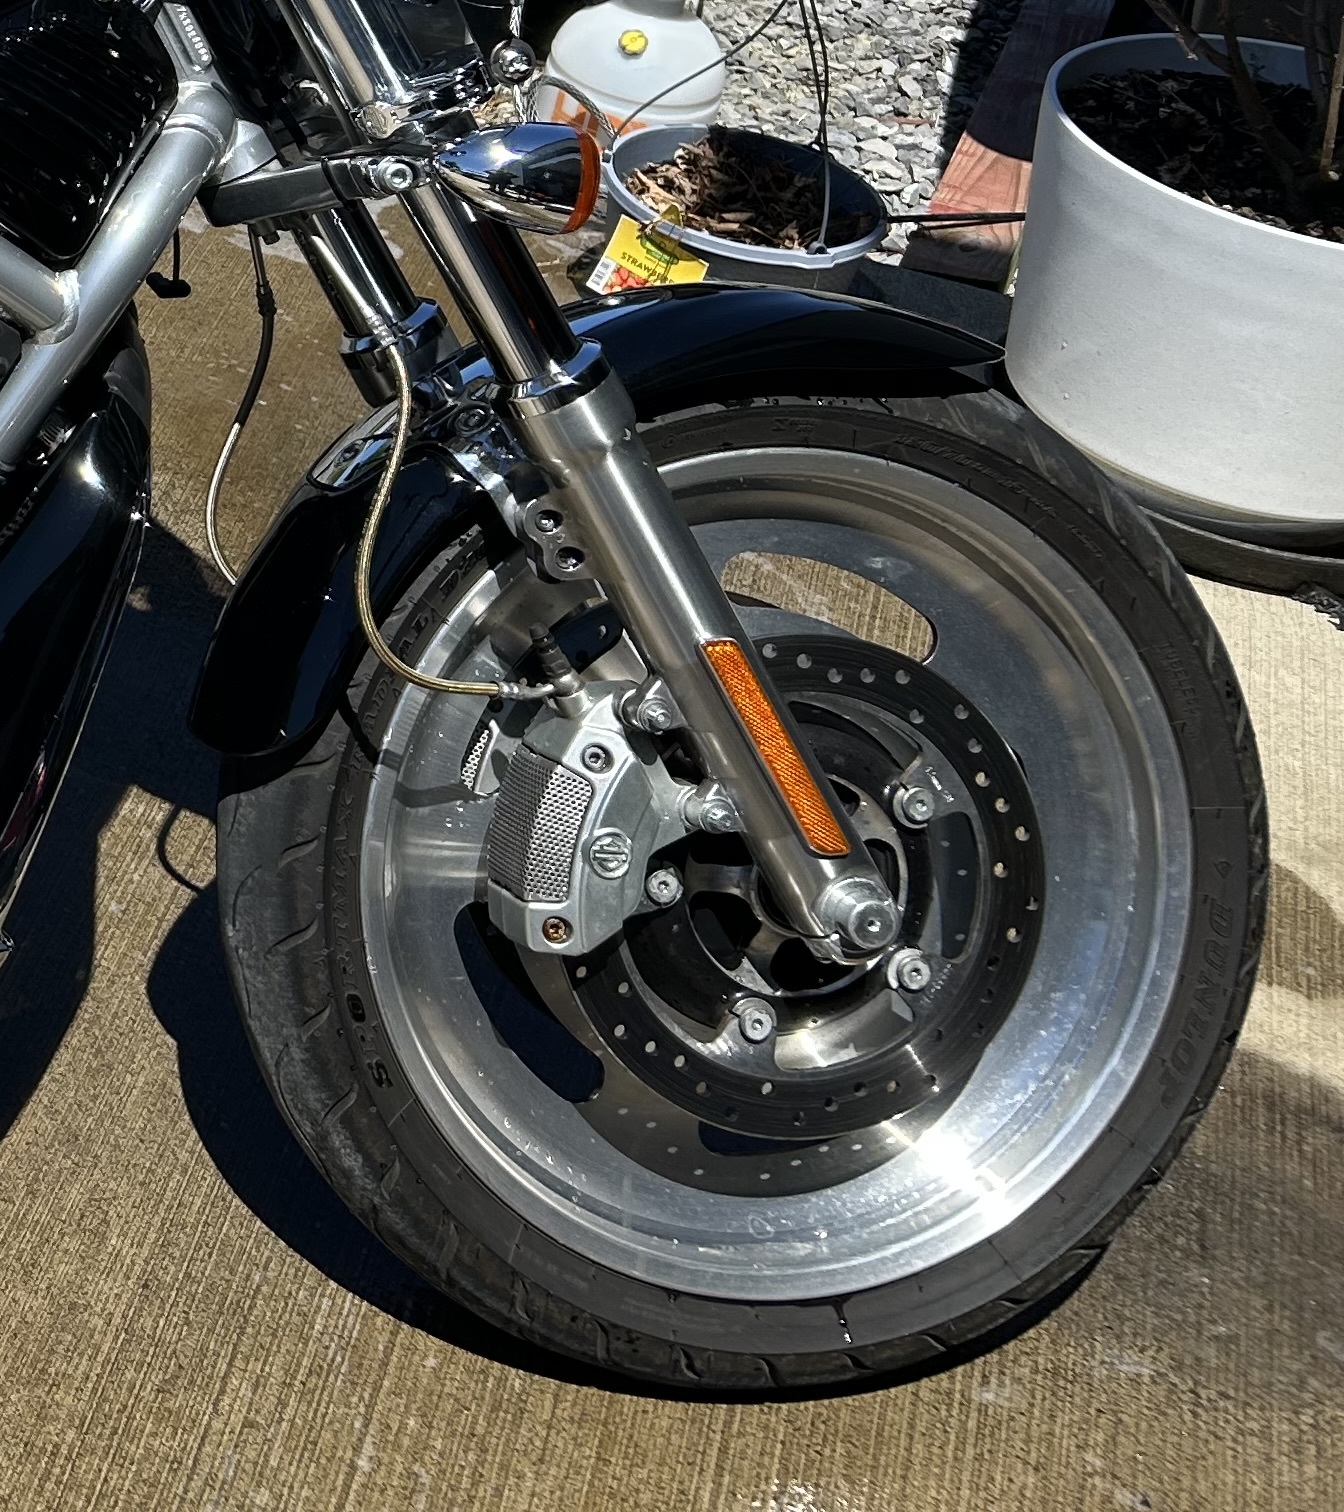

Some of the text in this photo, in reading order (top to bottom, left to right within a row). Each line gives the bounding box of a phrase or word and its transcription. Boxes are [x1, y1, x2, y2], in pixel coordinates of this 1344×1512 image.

[348, 613, 430, 773] RADAL
[332, 788, 393, 1088] SPORTMAX
[1161, 895, 1233, 1109] DUNLOP
